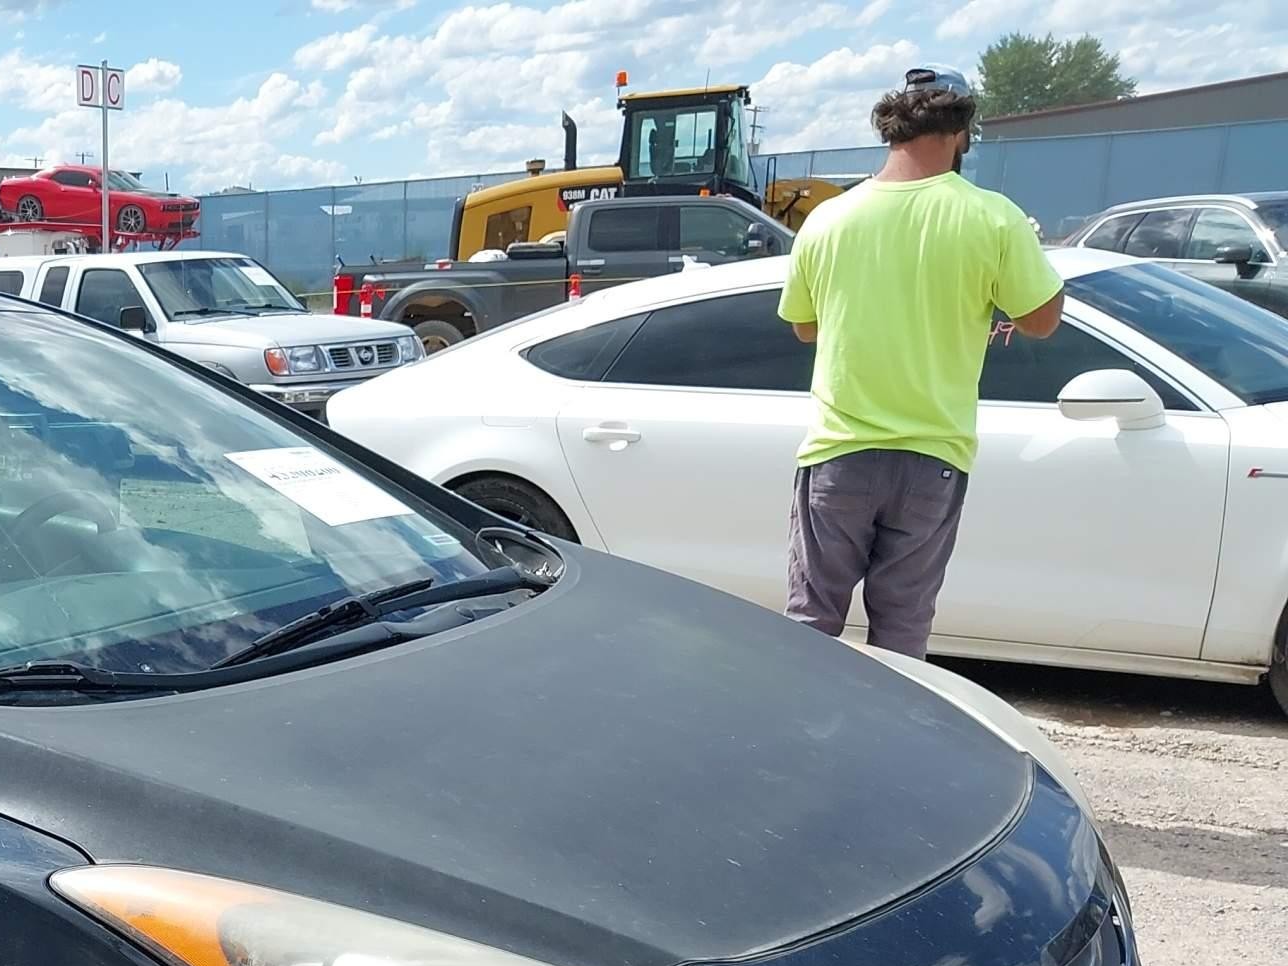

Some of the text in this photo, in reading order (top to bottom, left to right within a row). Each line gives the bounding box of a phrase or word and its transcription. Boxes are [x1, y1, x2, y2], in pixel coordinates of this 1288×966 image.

[81, 70, 120, 105] D C
[562, 187, 618, 201] 938M CAT
